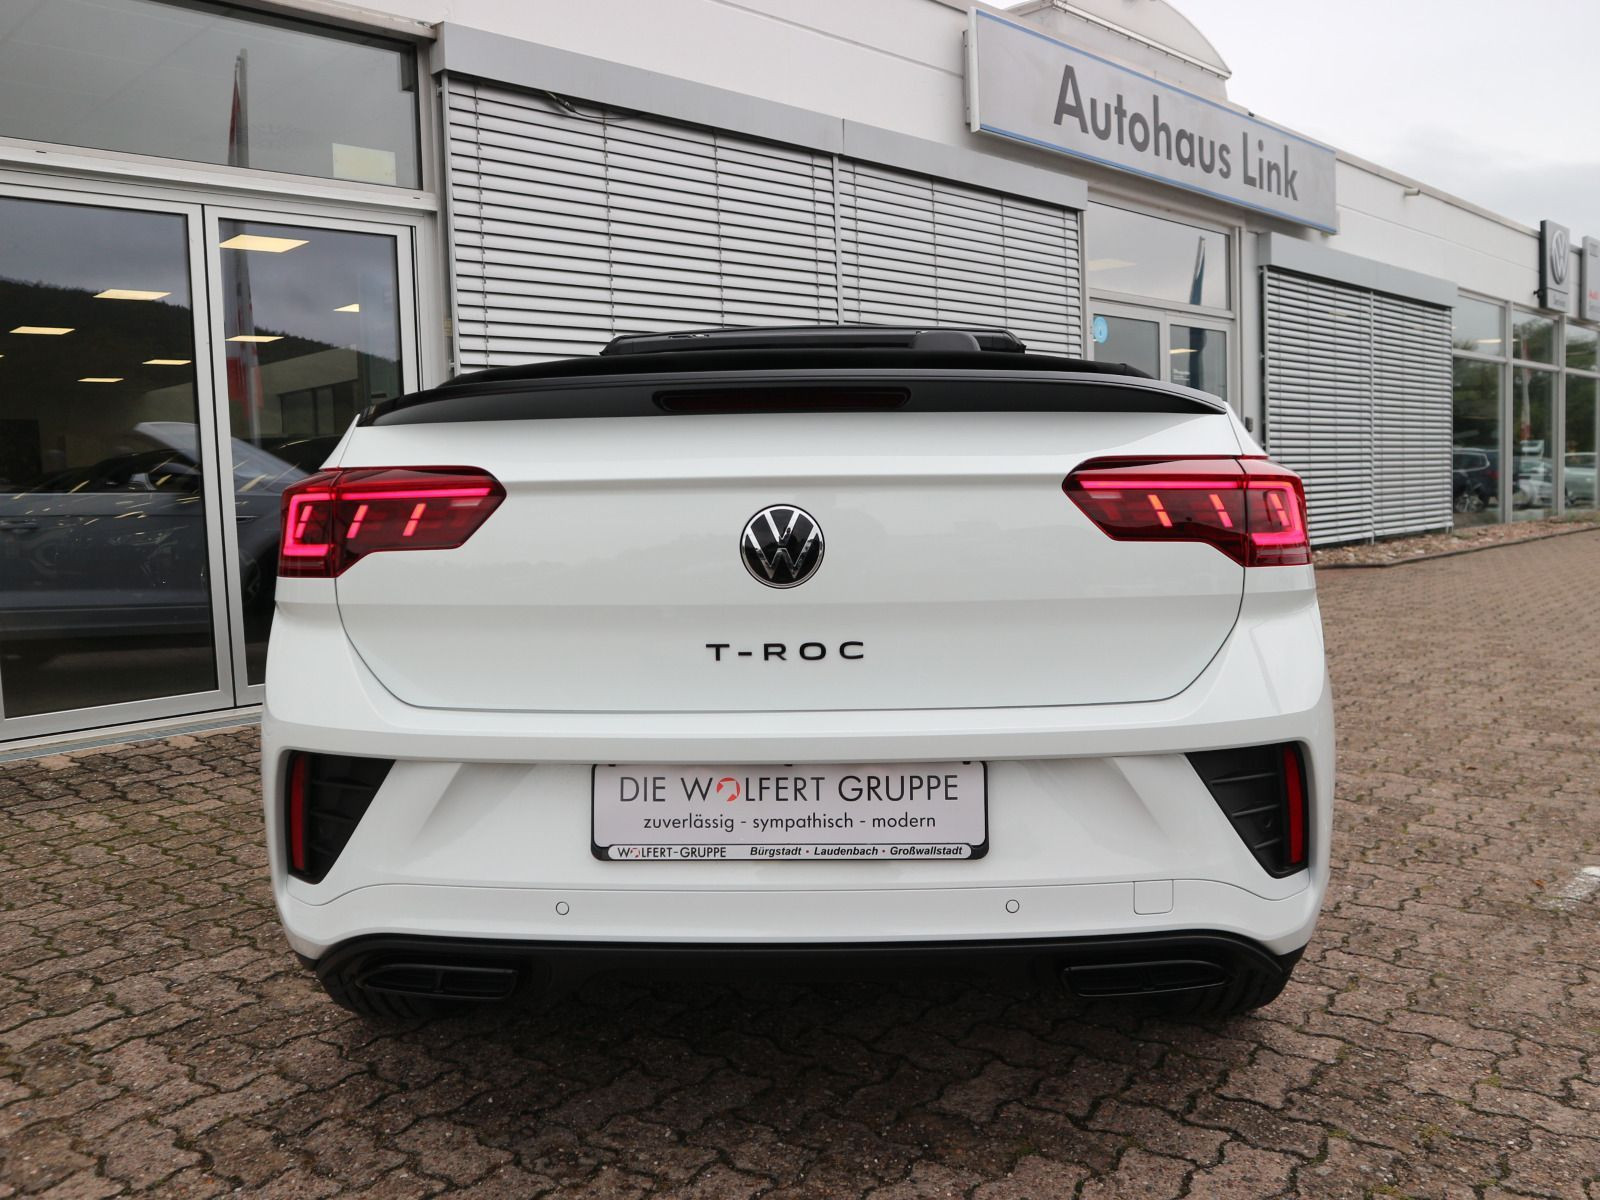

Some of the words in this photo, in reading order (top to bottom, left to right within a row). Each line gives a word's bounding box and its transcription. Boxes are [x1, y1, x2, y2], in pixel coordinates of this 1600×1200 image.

[1053, 64, 1232, 180] Autohaus
[1242, 131, 1299, 201] Link
[705, 640, 864, 662] T-ROC
[620, 776, 666, 802] DIE
[680, 776, 826, 803] WOLFERT
[838, 774, 959, 802] GRUPPE
[643, 812, 735, 833] zuverlässig
[752, 811, 854, 832] sympathisch
[872, 811, 936, 829] modern
[617, 846, 727, 859] WOLFERT-GRUPPE
[749, 846, 802, 857] Bürgstadt
[813, 846, 878, 856] Laudenbach
[889, 845, 963, 856] Großwallstadt
